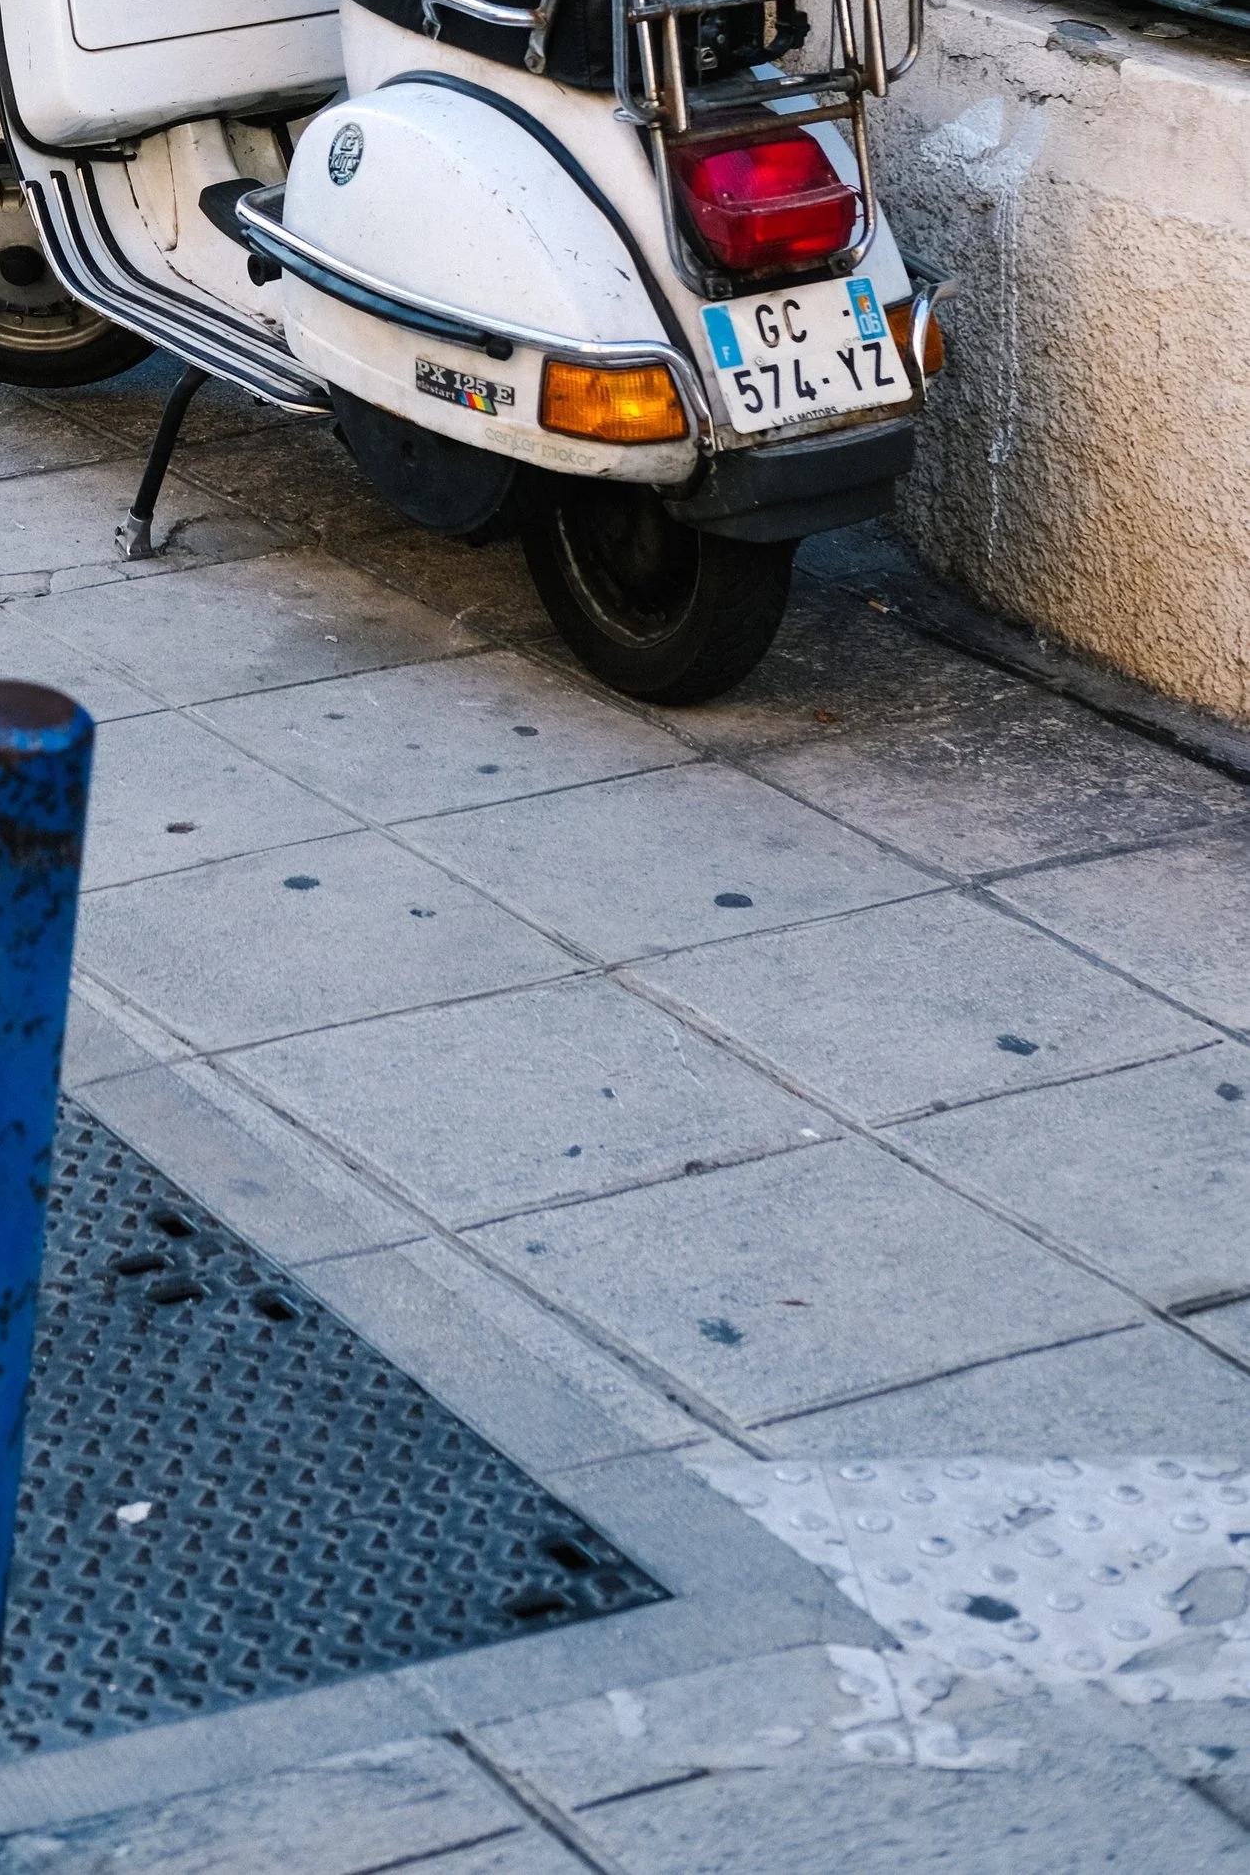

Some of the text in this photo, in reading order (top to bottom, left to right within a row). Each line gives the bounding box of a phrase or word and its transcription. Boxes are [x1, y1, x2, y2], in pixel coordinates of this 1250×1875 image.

[755, 299, 807, 348] GC
[858, 312, 883, 335] 06
[721, 346, 731, 362] F
[416, 359, 513, 405] PX 125 E
[417, 379, 456, 401] elestart
[541, 444, 596, 467] motor
